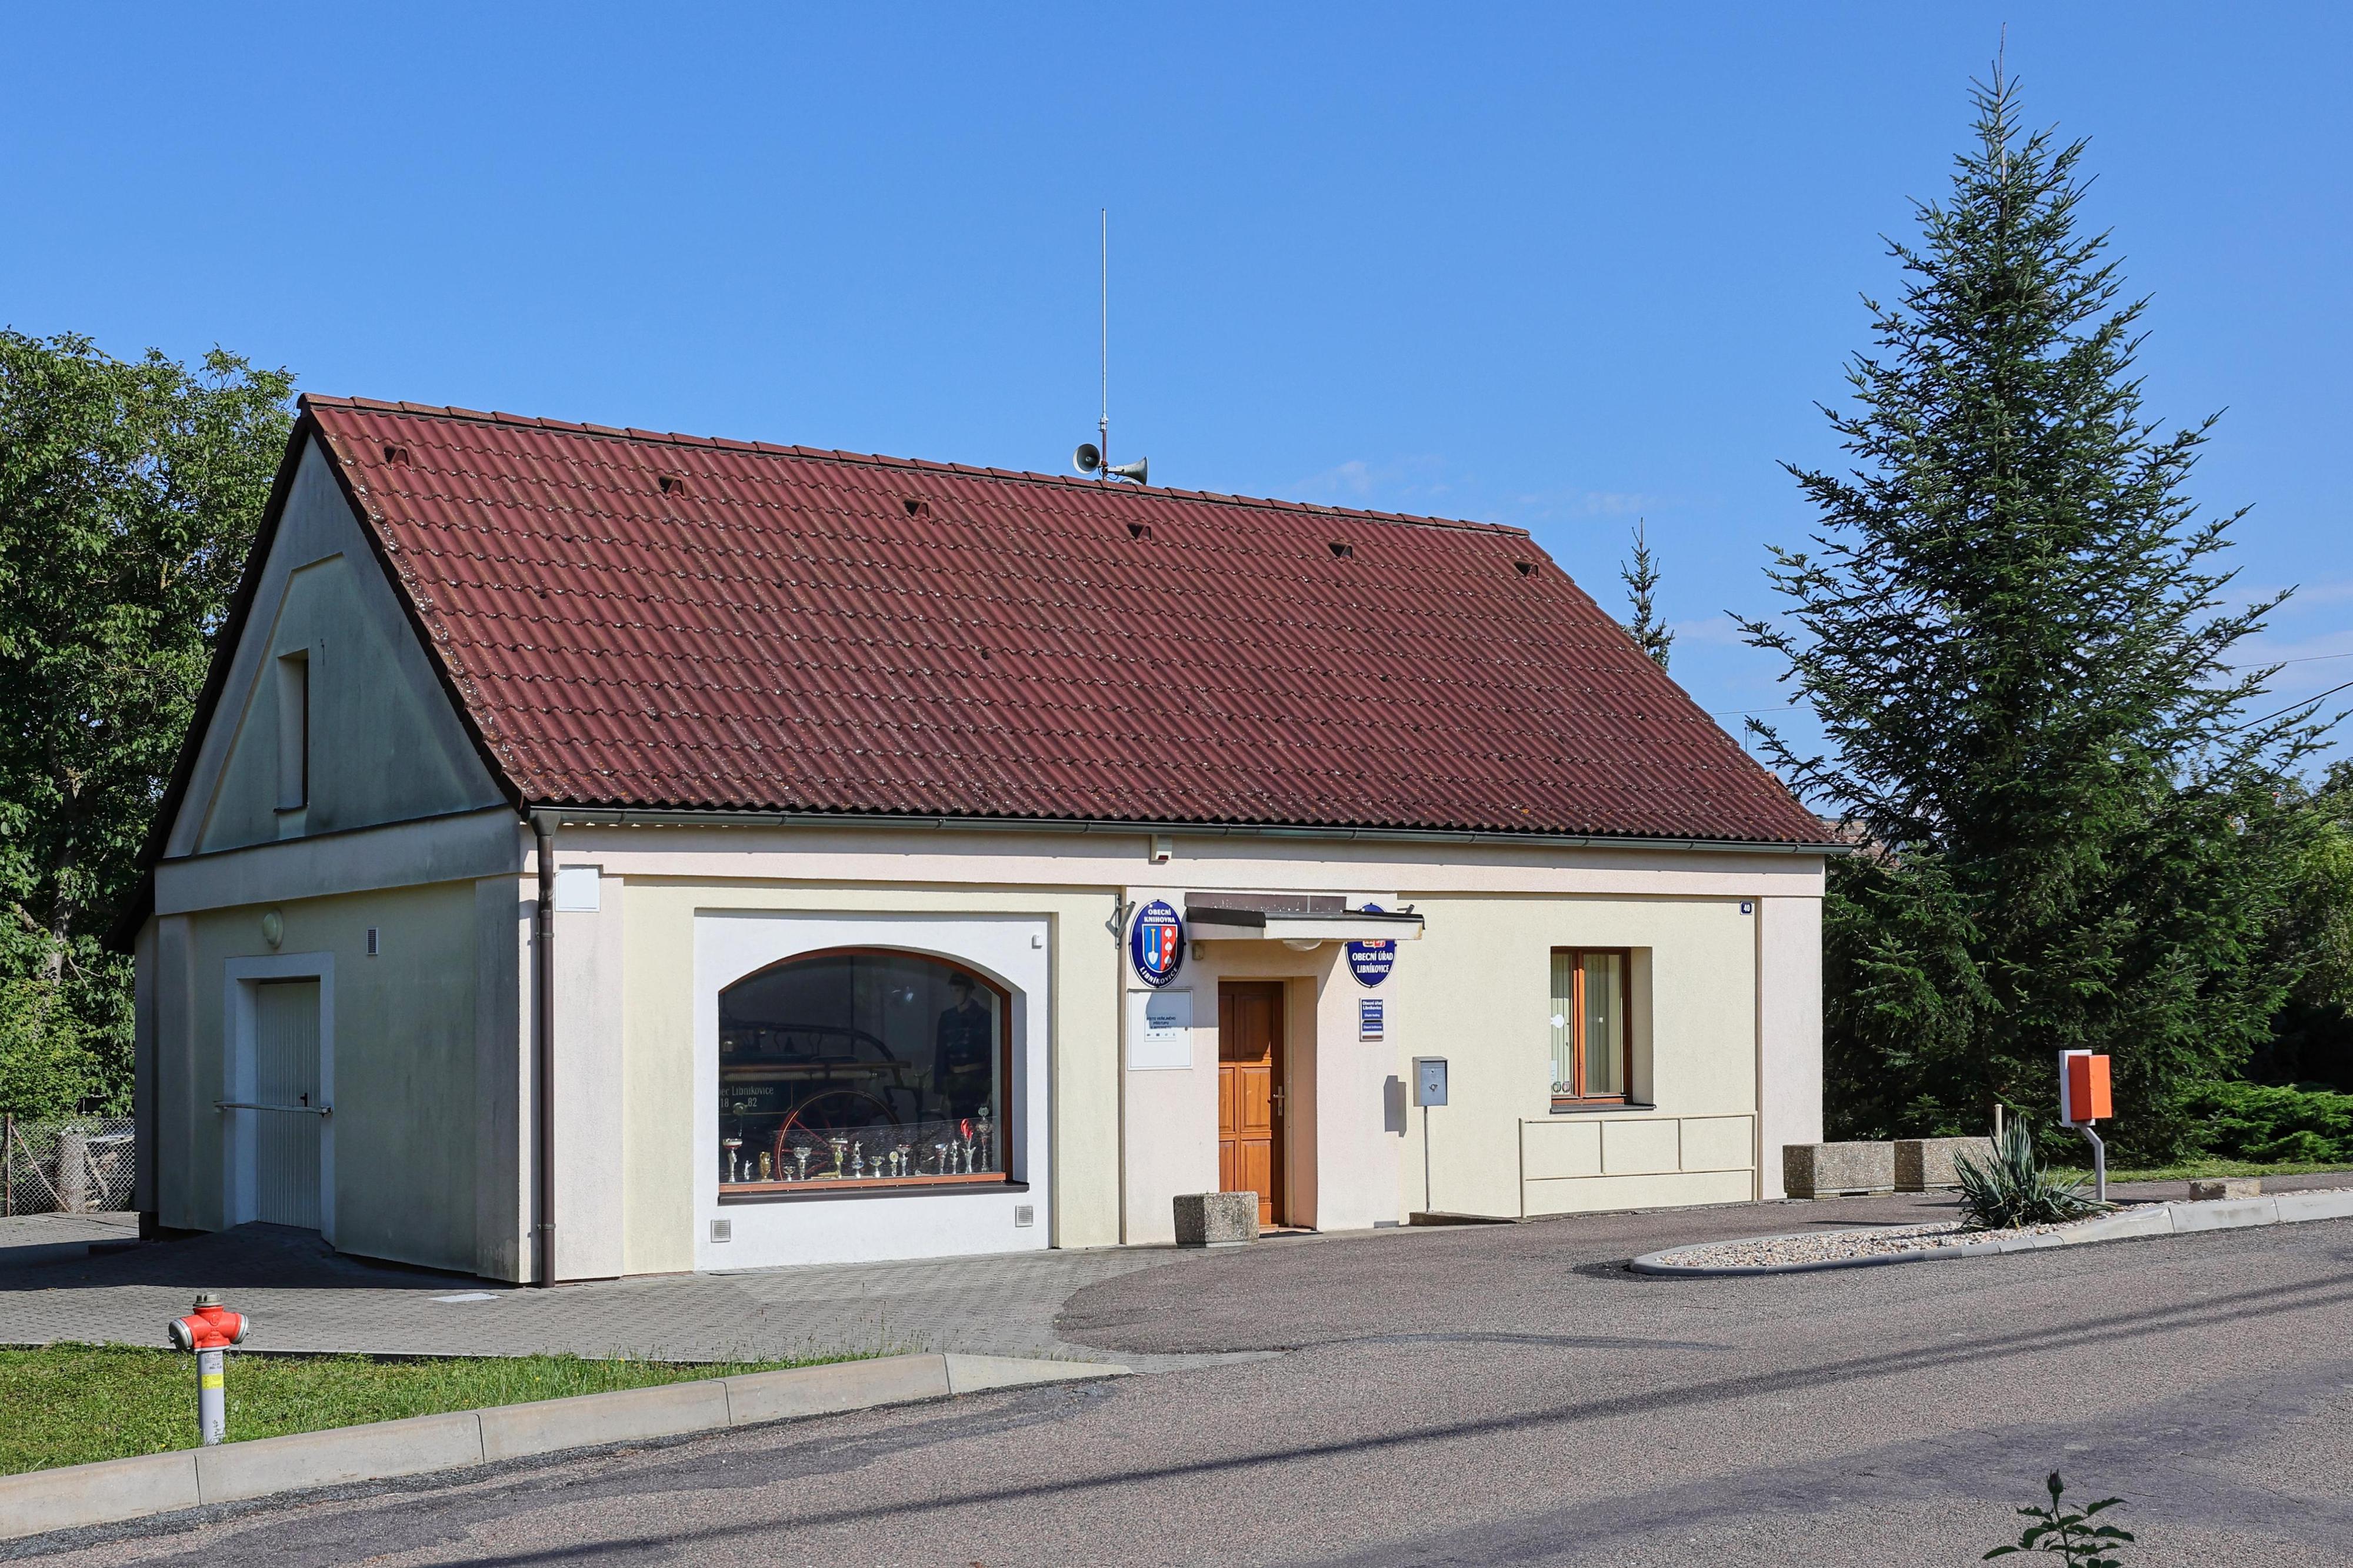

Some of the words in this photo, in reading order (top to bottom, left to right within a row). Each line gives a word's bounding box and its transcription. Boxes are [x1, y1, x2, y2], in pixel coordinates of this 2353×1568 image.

[1352, 950, 1377, 960] OBECNÍ
[1378, 950, 1394, 960] ÚŘAD
[1357, 962, 1389, 973] LIBNÍKOVICE
[1139, 966, 1178, 985] LIBNÍKOVICE
[721, 1098, 729, 1107] 18
[748, 1097, 757, 1107] 82
